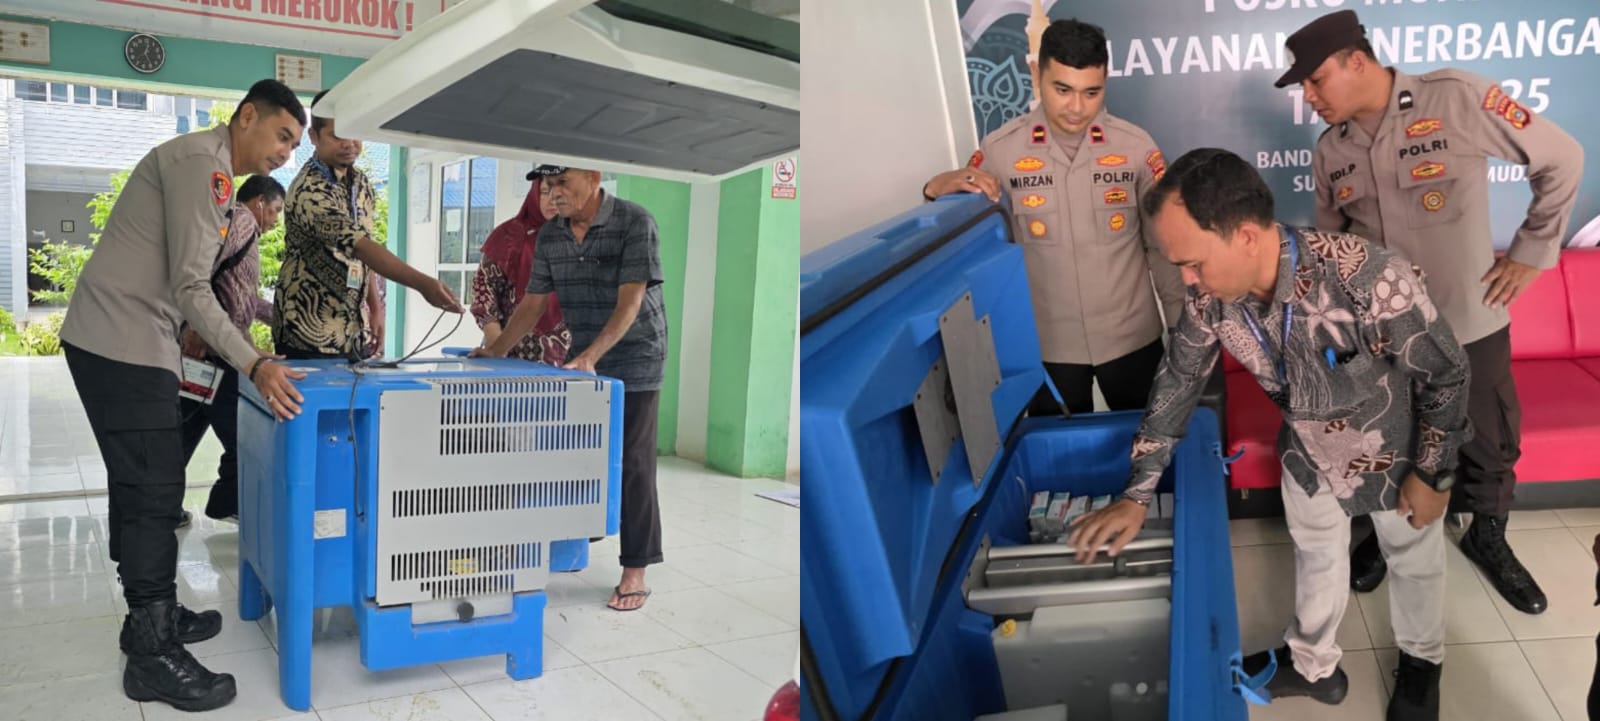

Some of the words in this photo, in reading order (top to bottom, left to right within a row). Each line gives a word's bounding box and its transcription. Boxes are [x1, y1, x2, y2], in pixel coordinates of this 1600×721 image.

[1371, 17, 1600, 64] NERBANGA
[1399, 139, 1449, 160] POLRI
[1009, 175, 1053, 189] MIRZAN
[1093, 172, 1134, 184] POLRI
